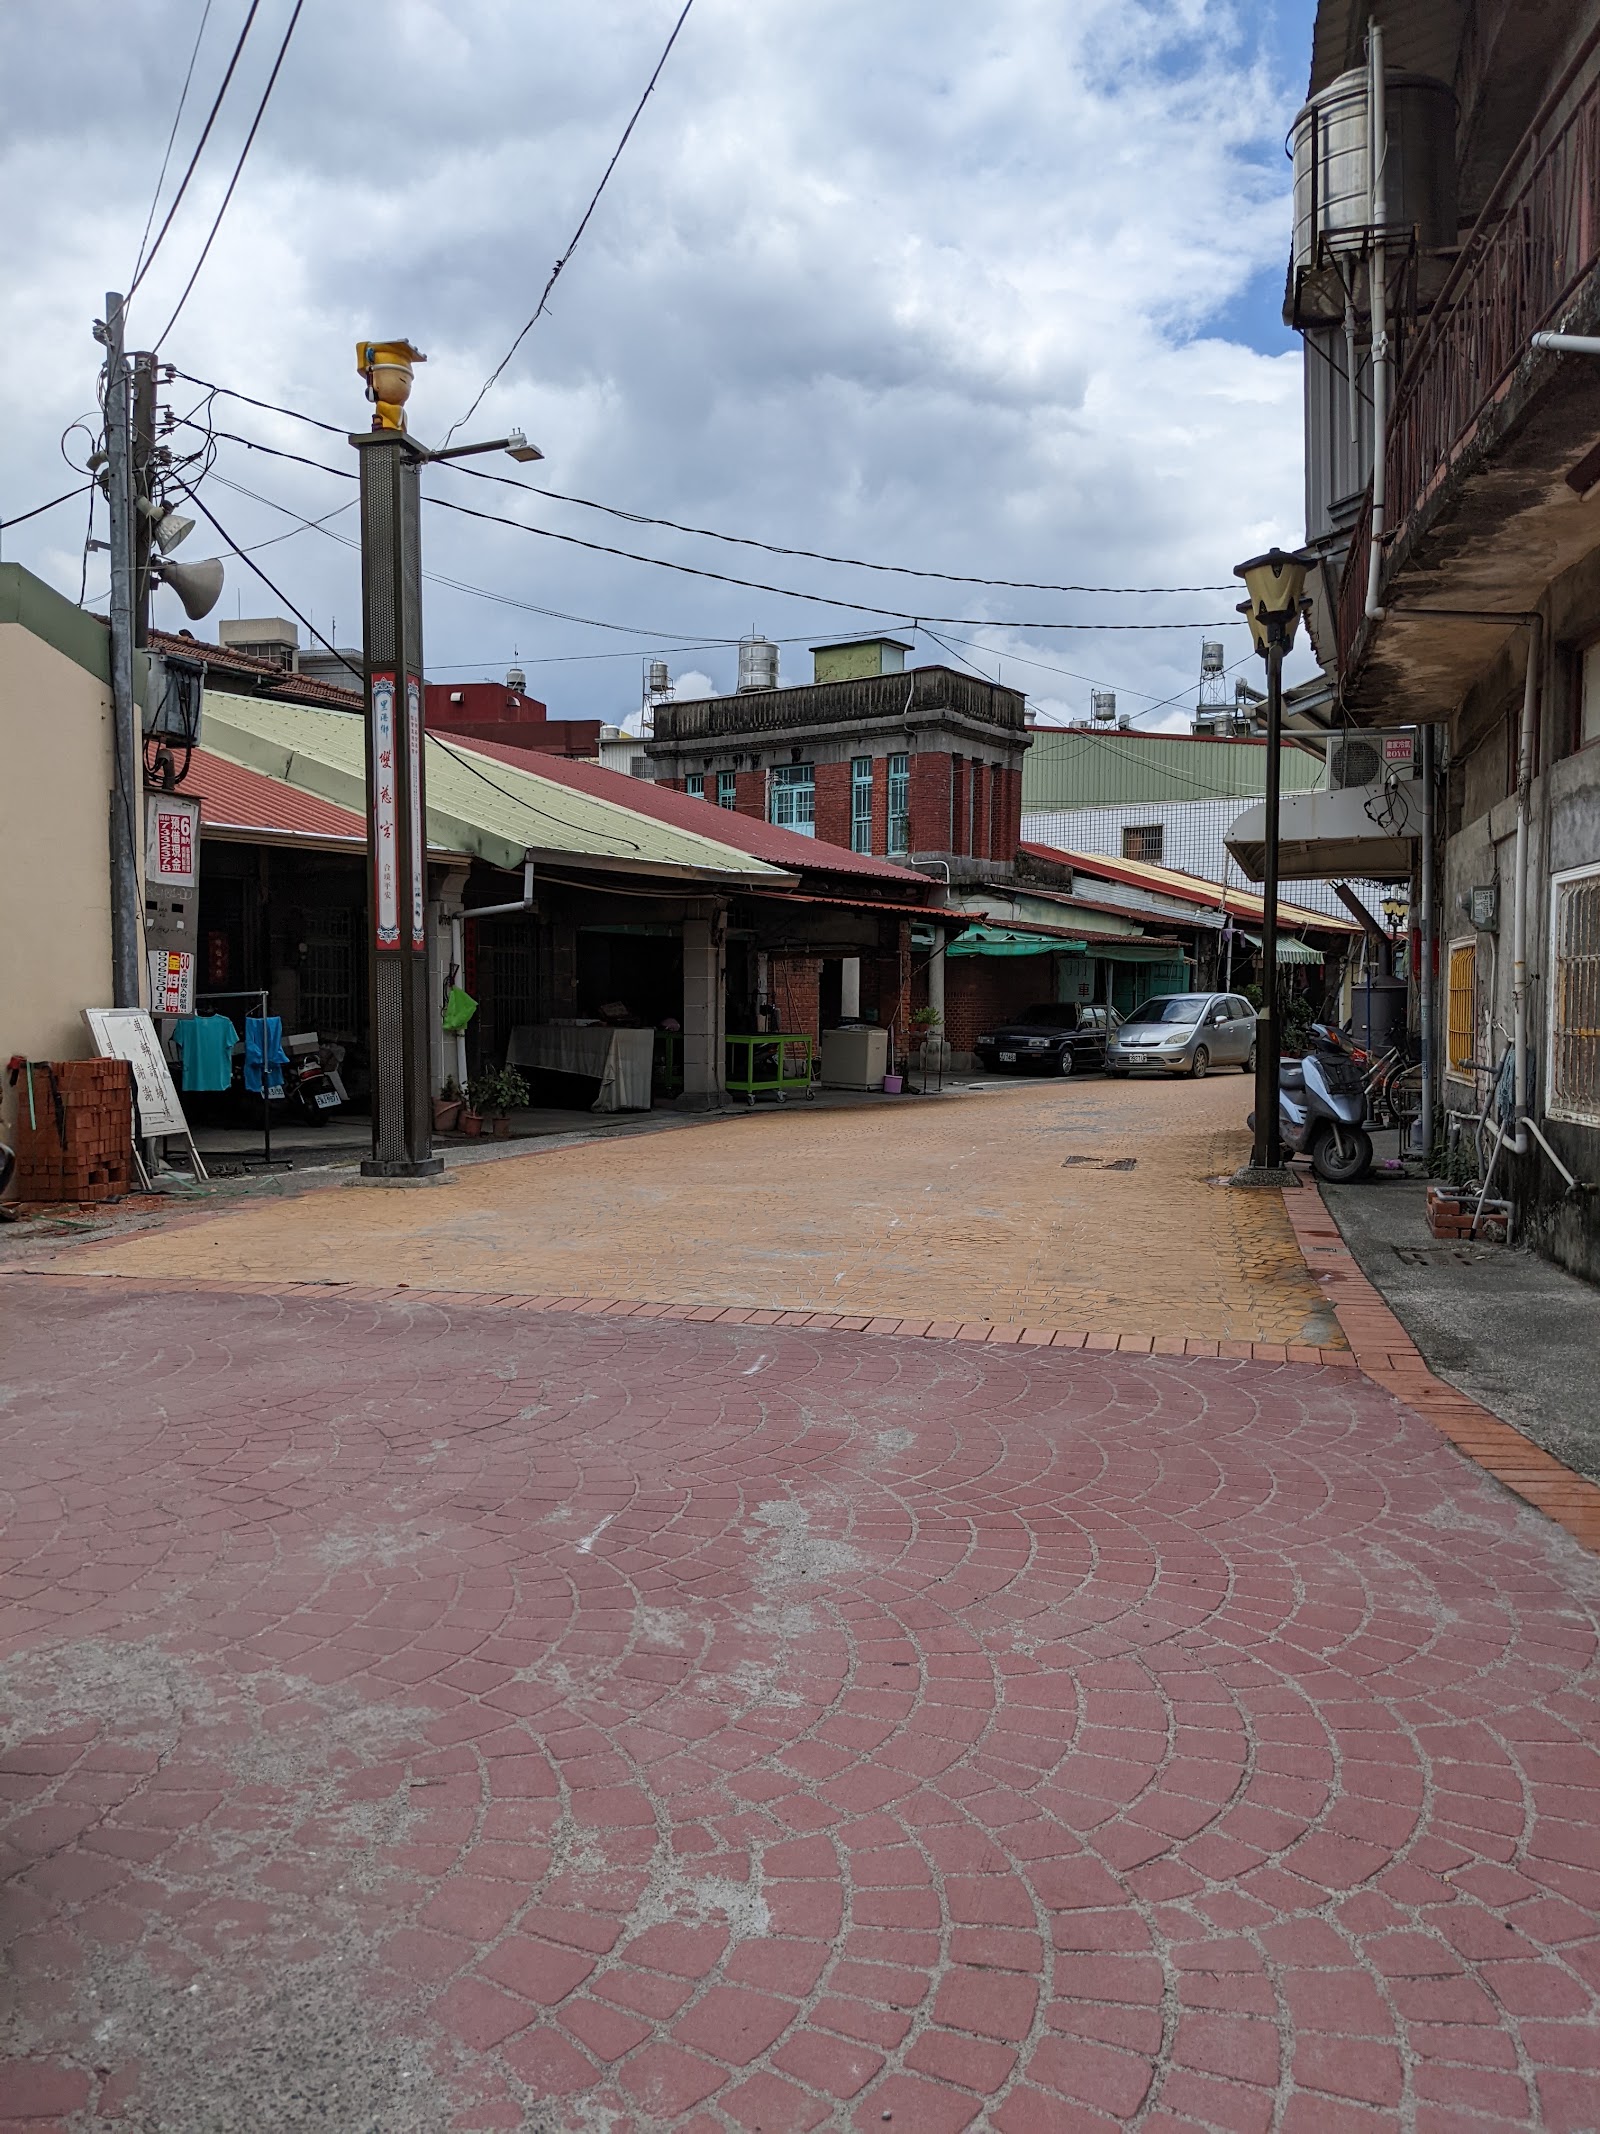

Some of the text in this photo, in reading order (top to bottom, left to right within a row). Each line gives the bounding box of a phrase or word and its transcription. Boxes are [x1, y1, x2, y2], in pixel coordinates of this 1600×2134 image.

[170, 816, 182, 872] 預借現金
[1078, 983, 1090, 997] 車
